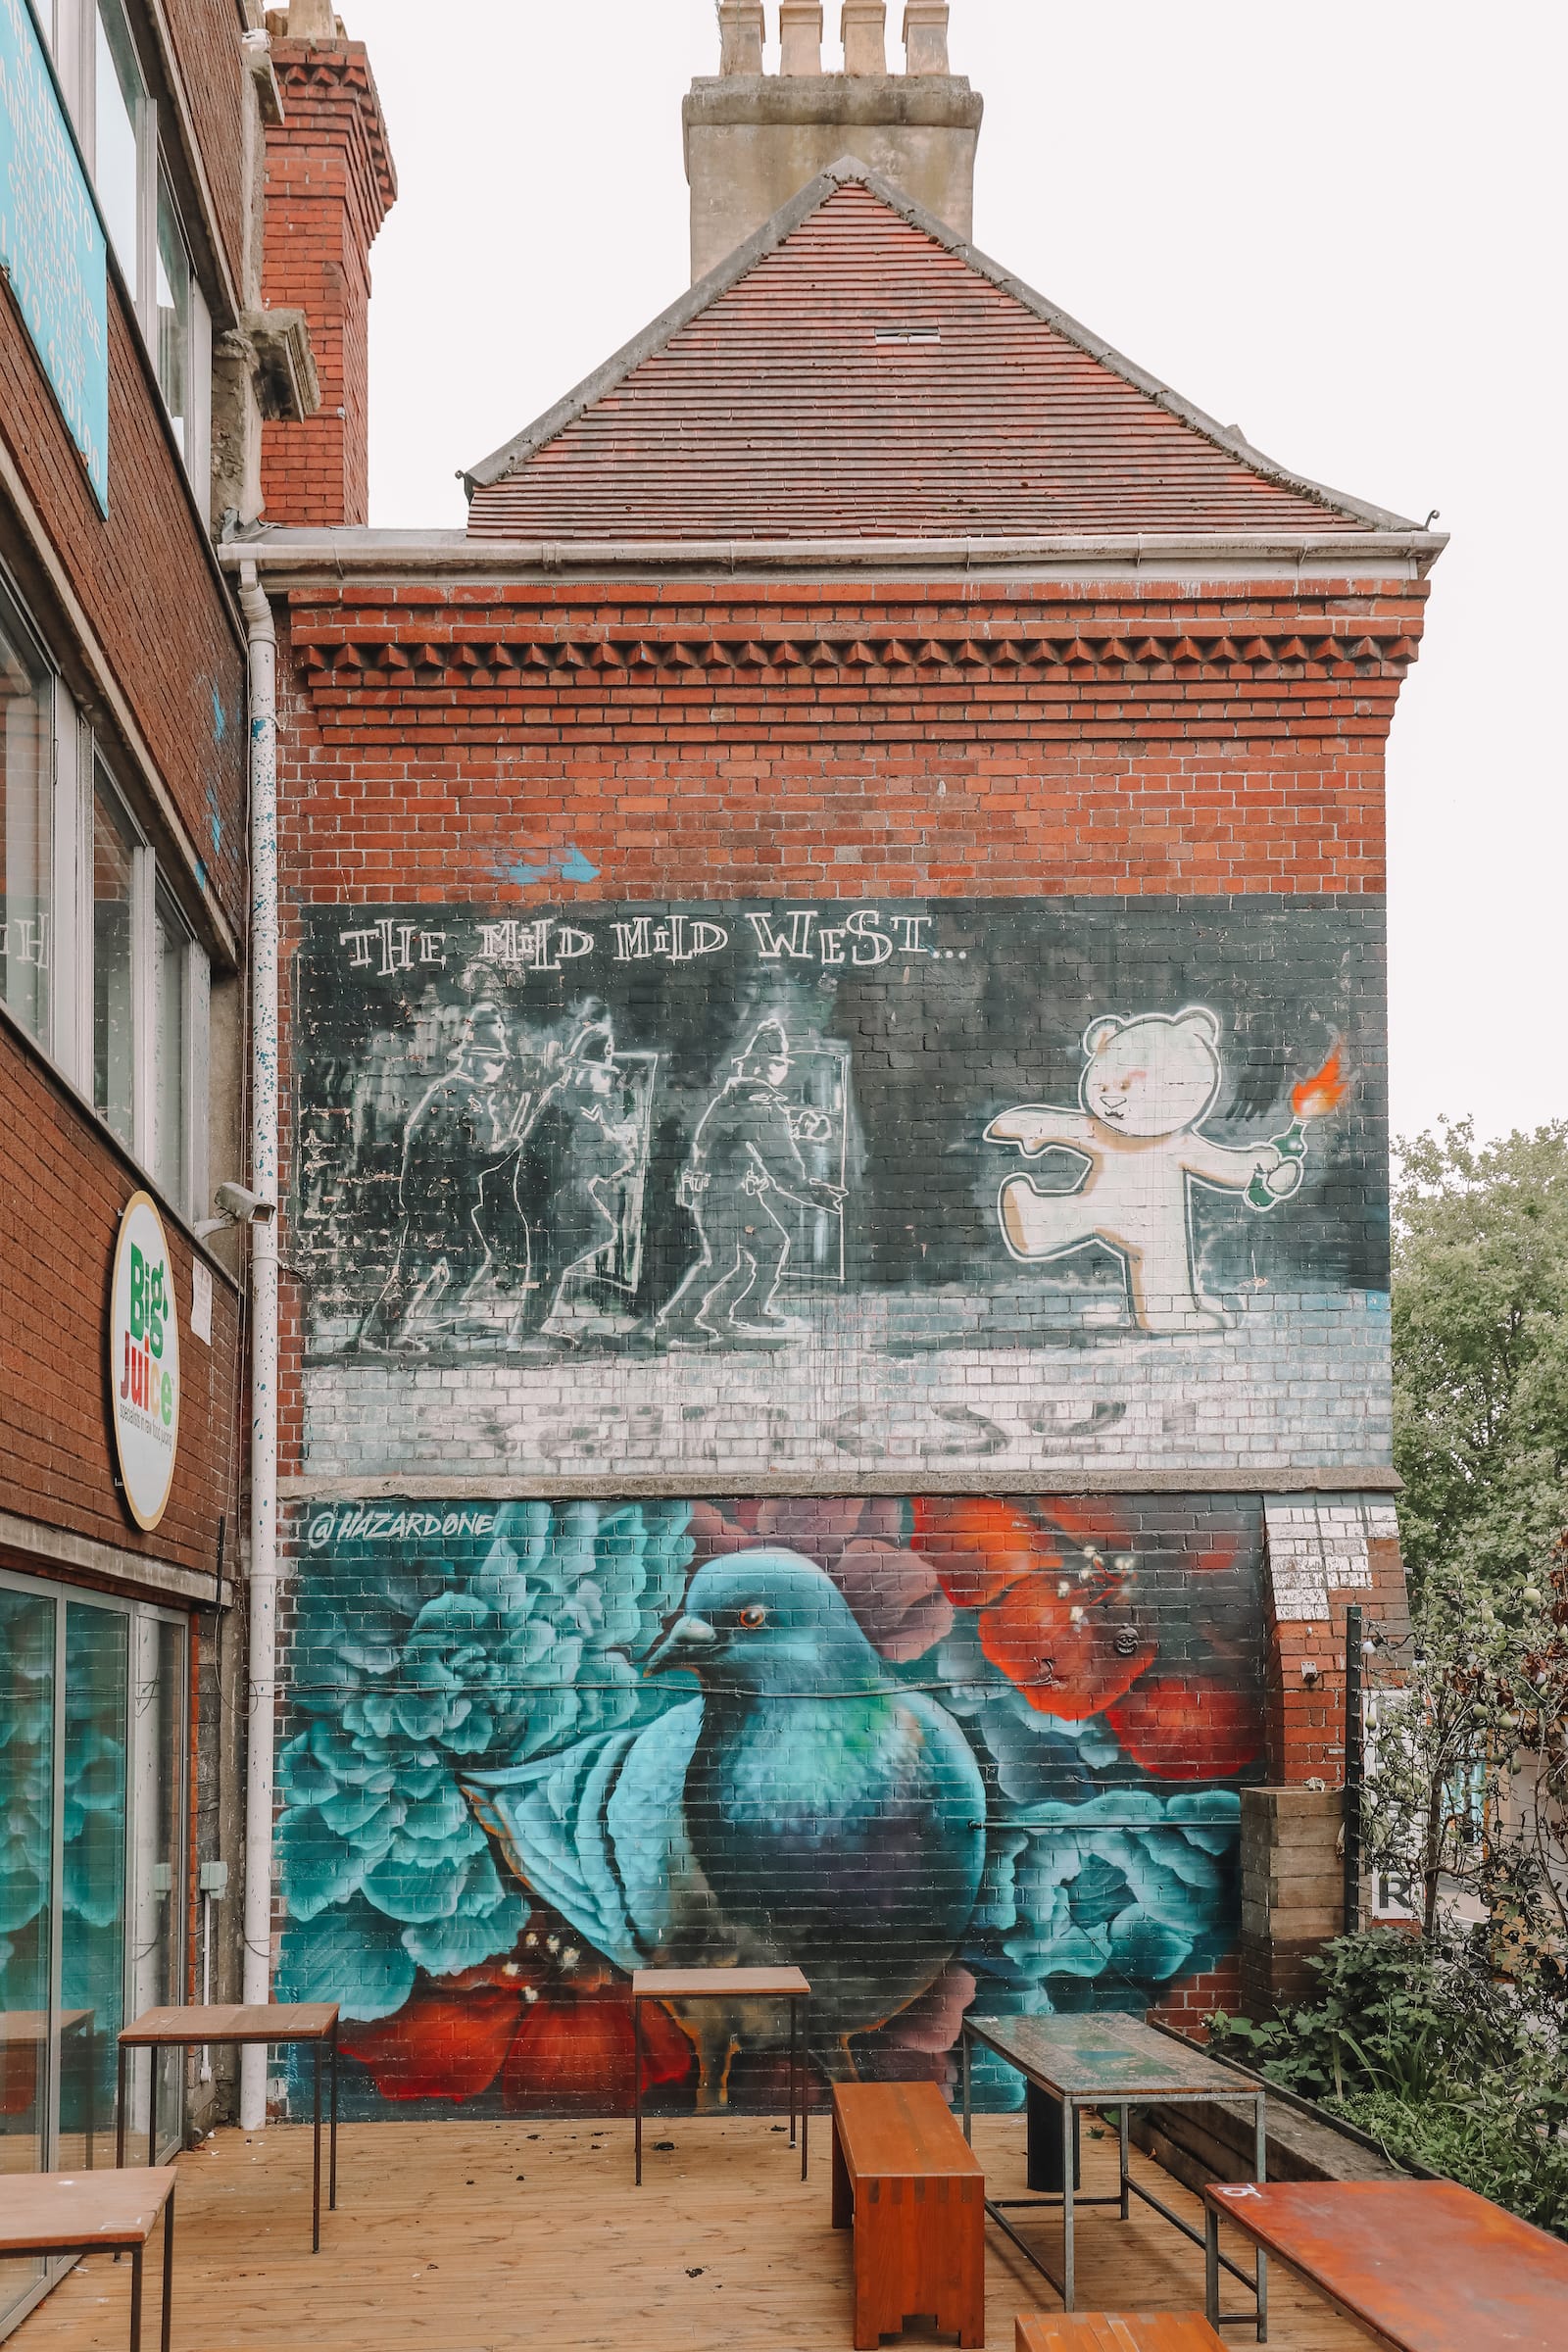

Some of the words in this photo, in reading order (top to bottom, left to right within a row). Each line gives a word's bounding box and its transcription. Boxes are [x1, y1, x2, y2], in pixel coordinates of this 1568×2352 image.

[16, 56, 77, 253] SUPPORT
[37, 69, 74, 204] HERE
[76, 180, 93, 252] TO
[61, 224, 100, 361] HOUSE
[339, 919, 447, 976] THE
[130, 1242, 168, 1359] Big
[121, 1330, 172, 1426] Juice
